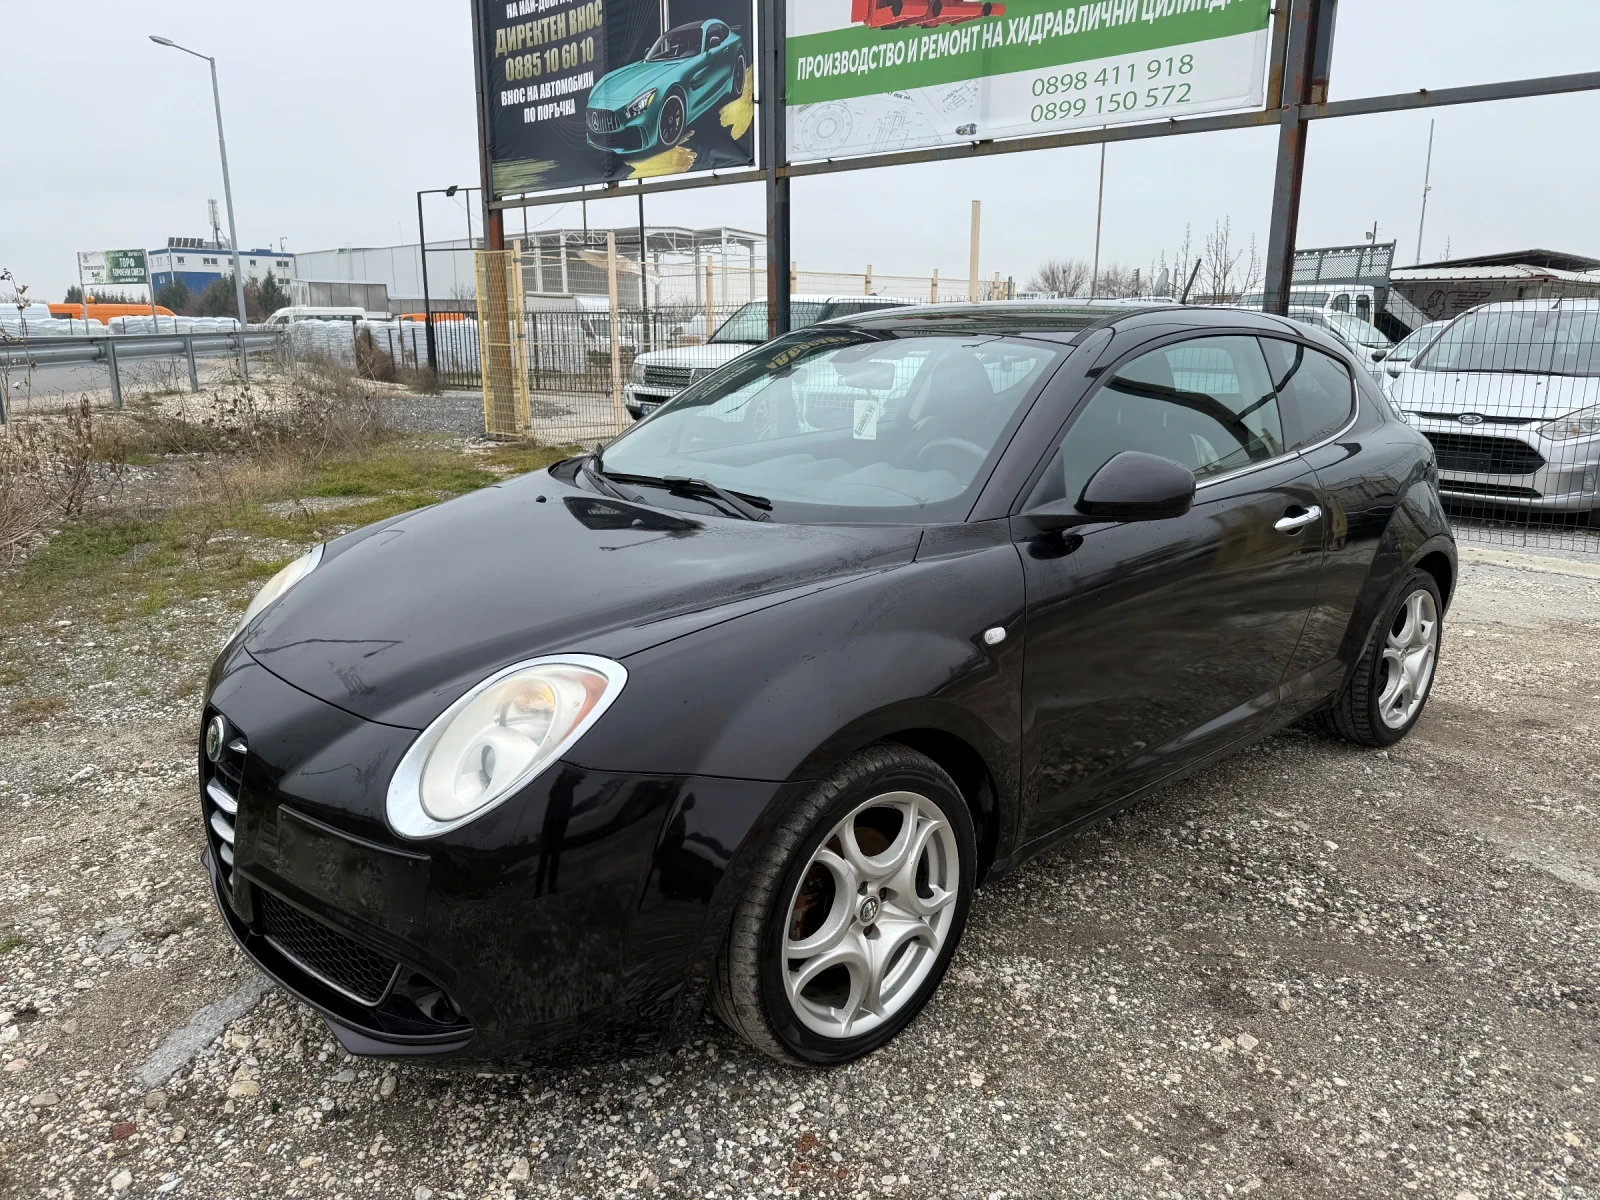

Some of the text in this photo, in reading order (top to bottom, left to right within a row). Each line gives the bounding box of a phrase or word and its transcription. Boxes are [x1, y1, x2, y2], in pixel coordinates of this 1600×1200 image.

[495, 0, 603, 58] ДИРЕКТЕН ВНОС
[506, 2, 518, 19] НА
[505, 36, 594, 82] 0885 10 60 10
[797, 40, 905, 81] ПРОИЗВОДСТВО
[907, 37, 919, 63] И
[920, 24, 981, 61] РЕМОНТ
[982, 21, 1003, 49] НА
[1005, 0, 1138, 46] ХИДРАВЛИЧНИ
[501, 70, 594, 106] ВНОС НА АВТОМОБИЛИ
[1032, 54, 1194, 96] 0898 411 918
[523, 98, 576, 124] ПО ПОРЪЧКА
[1030, 82, 1192, 123] 0899 150 572
[119, 257, 135, 268] ТОРФ
